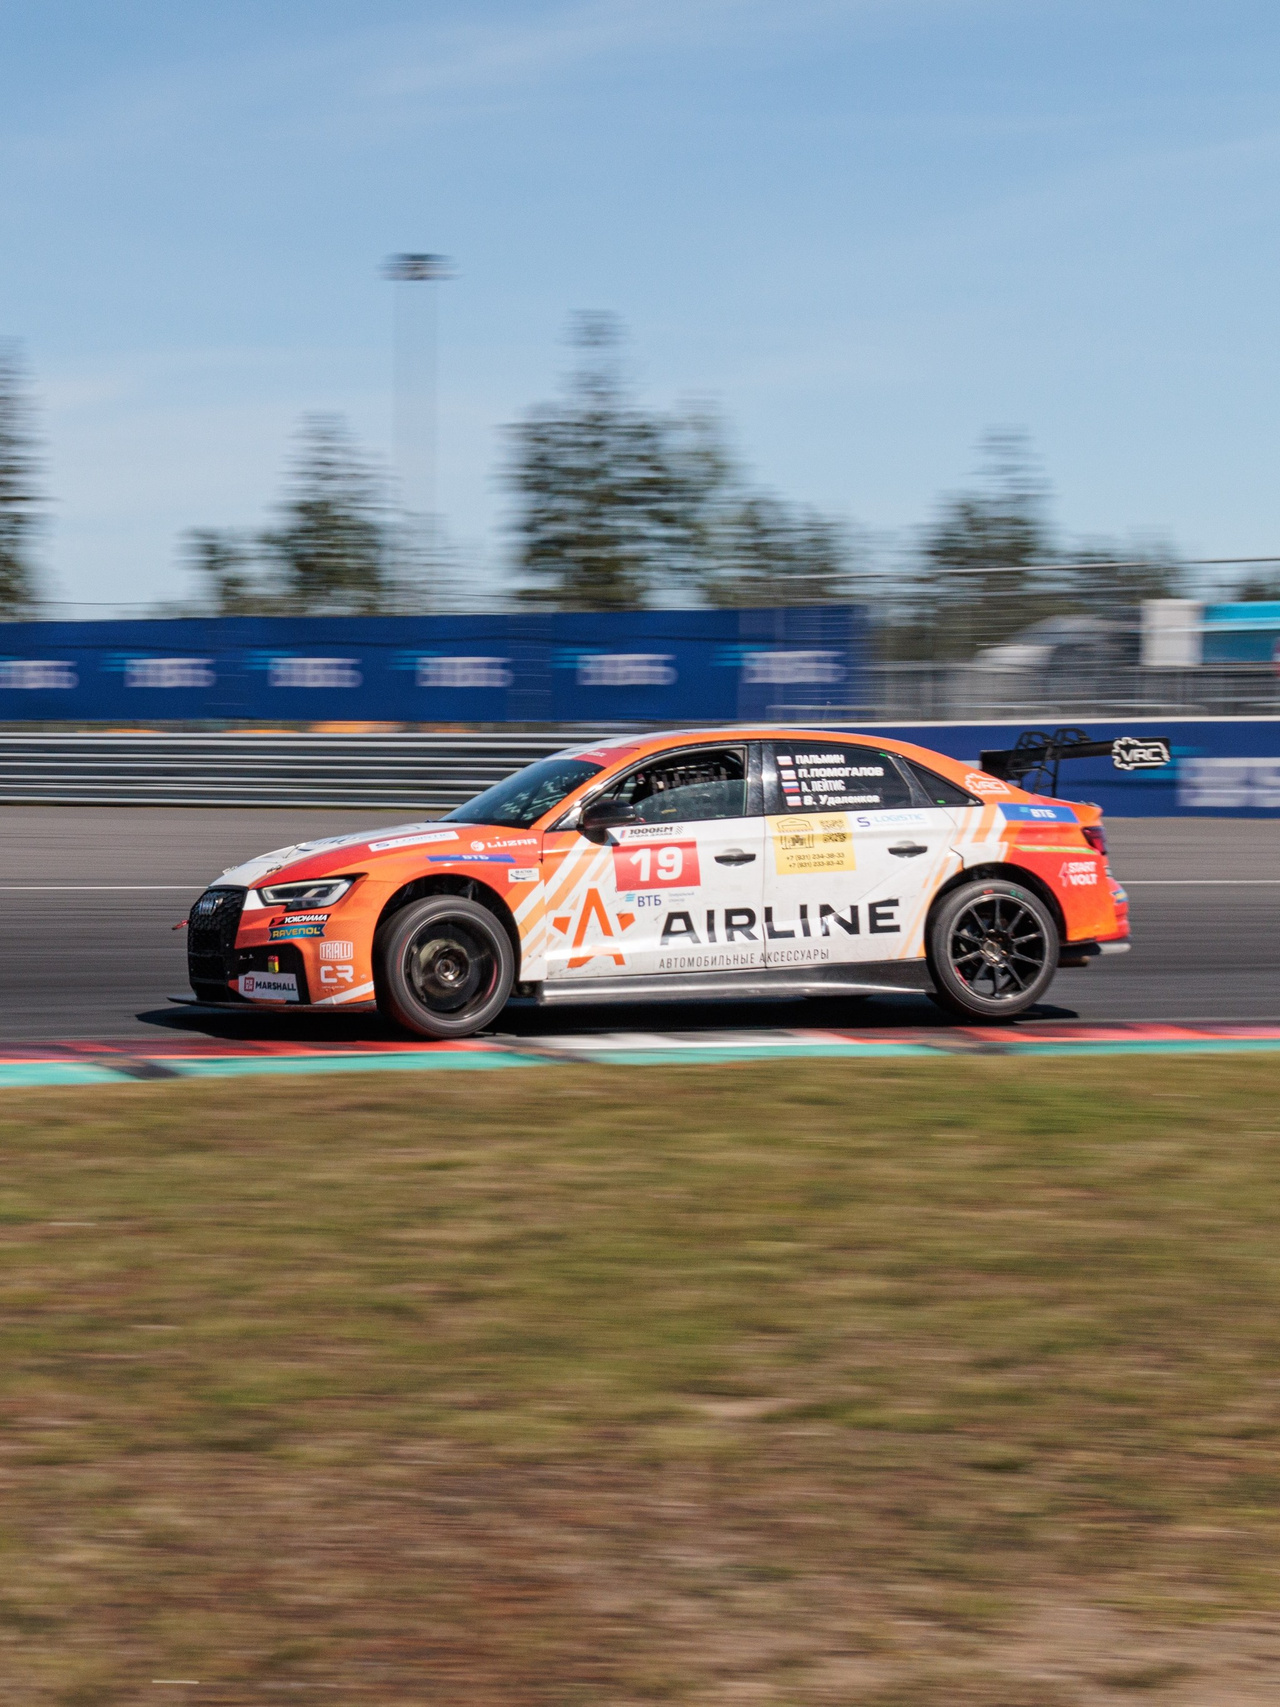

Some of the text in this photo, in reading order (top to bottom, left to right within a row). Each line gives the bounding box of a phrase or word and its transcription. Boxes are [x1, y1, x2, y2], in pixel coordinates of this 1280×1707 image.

[1120, 748, 1162, 761] VRC
[1029, 808, 1057, 819] ВТБ
[487, 838, 538, 849] LUZAR
[629, 846, 683, 882] 19
[1068, 861, 1097, 873] START
[1070, 873, 1098, 886] VOLT
[637, 895, 662, 907] ВТБ
[284, 914, 327, 923] YOKOHAMA
[660, 898, 901, 945] AIRLINE
[272, 927, 320, 938] RAVENOL
[321, 942, 351, 960] TRIALLI
[659, 948, 830, 969] АВТОМОБИЛЬНЫЕ АКСЕССУАРЫ
[320, 965, 354, 983] CR
[255, 981, 297, 991] MARSHALL
